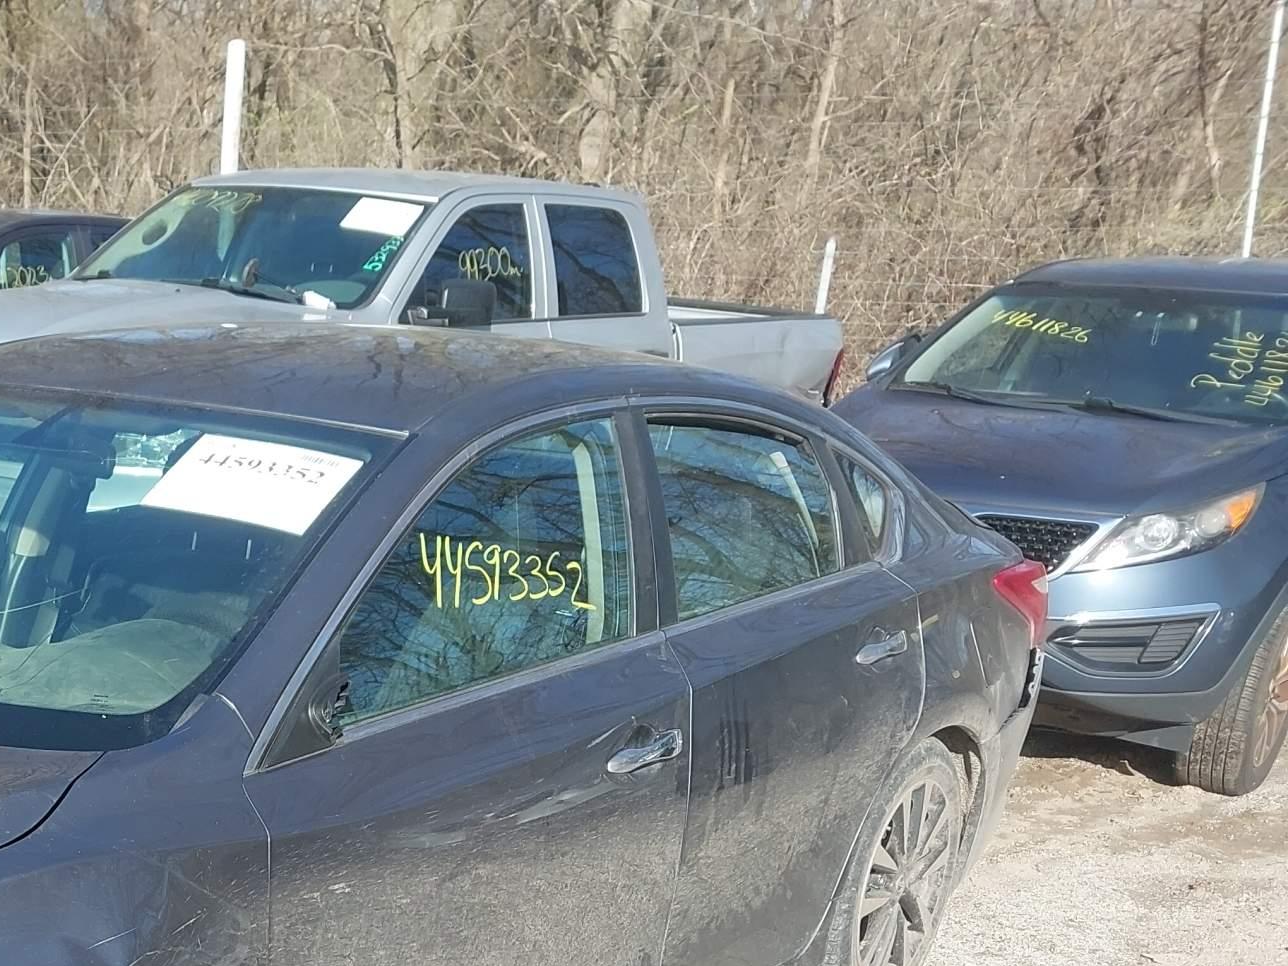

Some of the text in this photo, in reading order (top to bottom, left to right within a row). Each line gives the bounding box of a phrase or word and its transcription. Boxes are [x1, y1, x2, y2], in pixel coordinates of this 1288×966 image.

[992, 309, 1092, 343] 44611826
[1190, 331, 1265, 388] Peddle
[419, 532, 597, 610] 44593352
